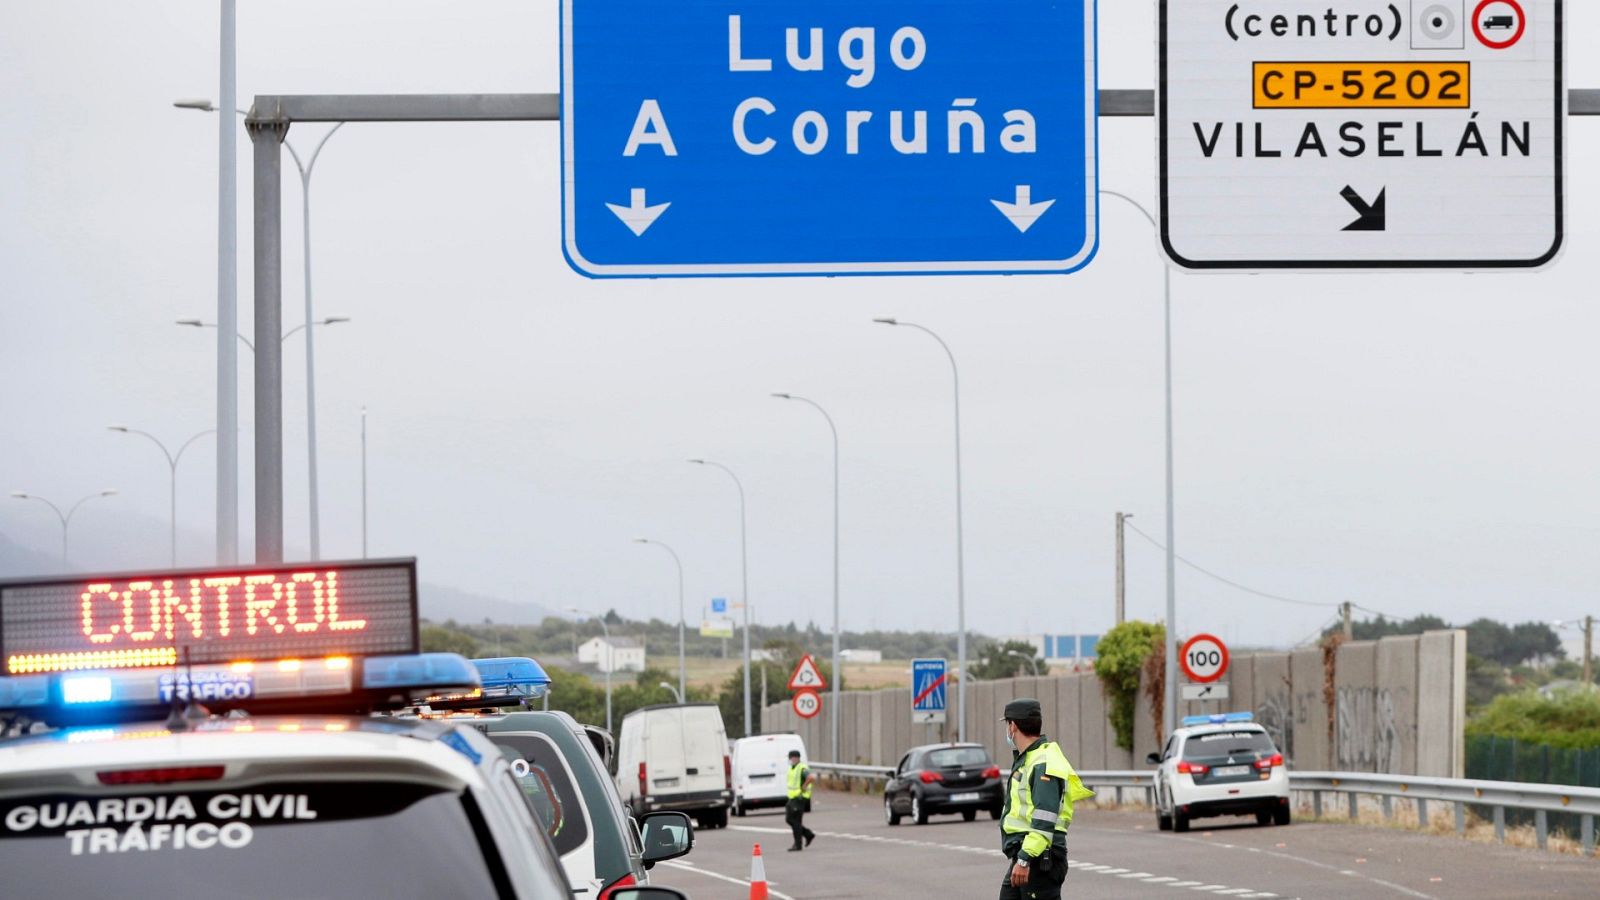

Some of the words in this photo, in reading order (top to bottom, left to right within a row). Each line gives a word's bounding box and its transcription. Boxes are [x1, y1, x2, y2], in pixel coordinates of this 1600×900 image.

[1225, 4, 1402, 41] (centro)
[728, 14, 927, 89] Lugo
[1261, 70, 1462, 100] CP-5202
[622, 99, 679, 157] A
[731, 96, 1037, 156] Coruña
[1192, 111, 1531, 158] VILASELÁN
[80, 571, 367, 644] CONTROL
[1188, 650, 1220, 667] 100
[800, 698, 815, 709] 70
[5, 795, 197, 831] GUARDIA
[206, 793, 318, 819] CIVIL
[65, 821, 254, 856] TRÁFICO
